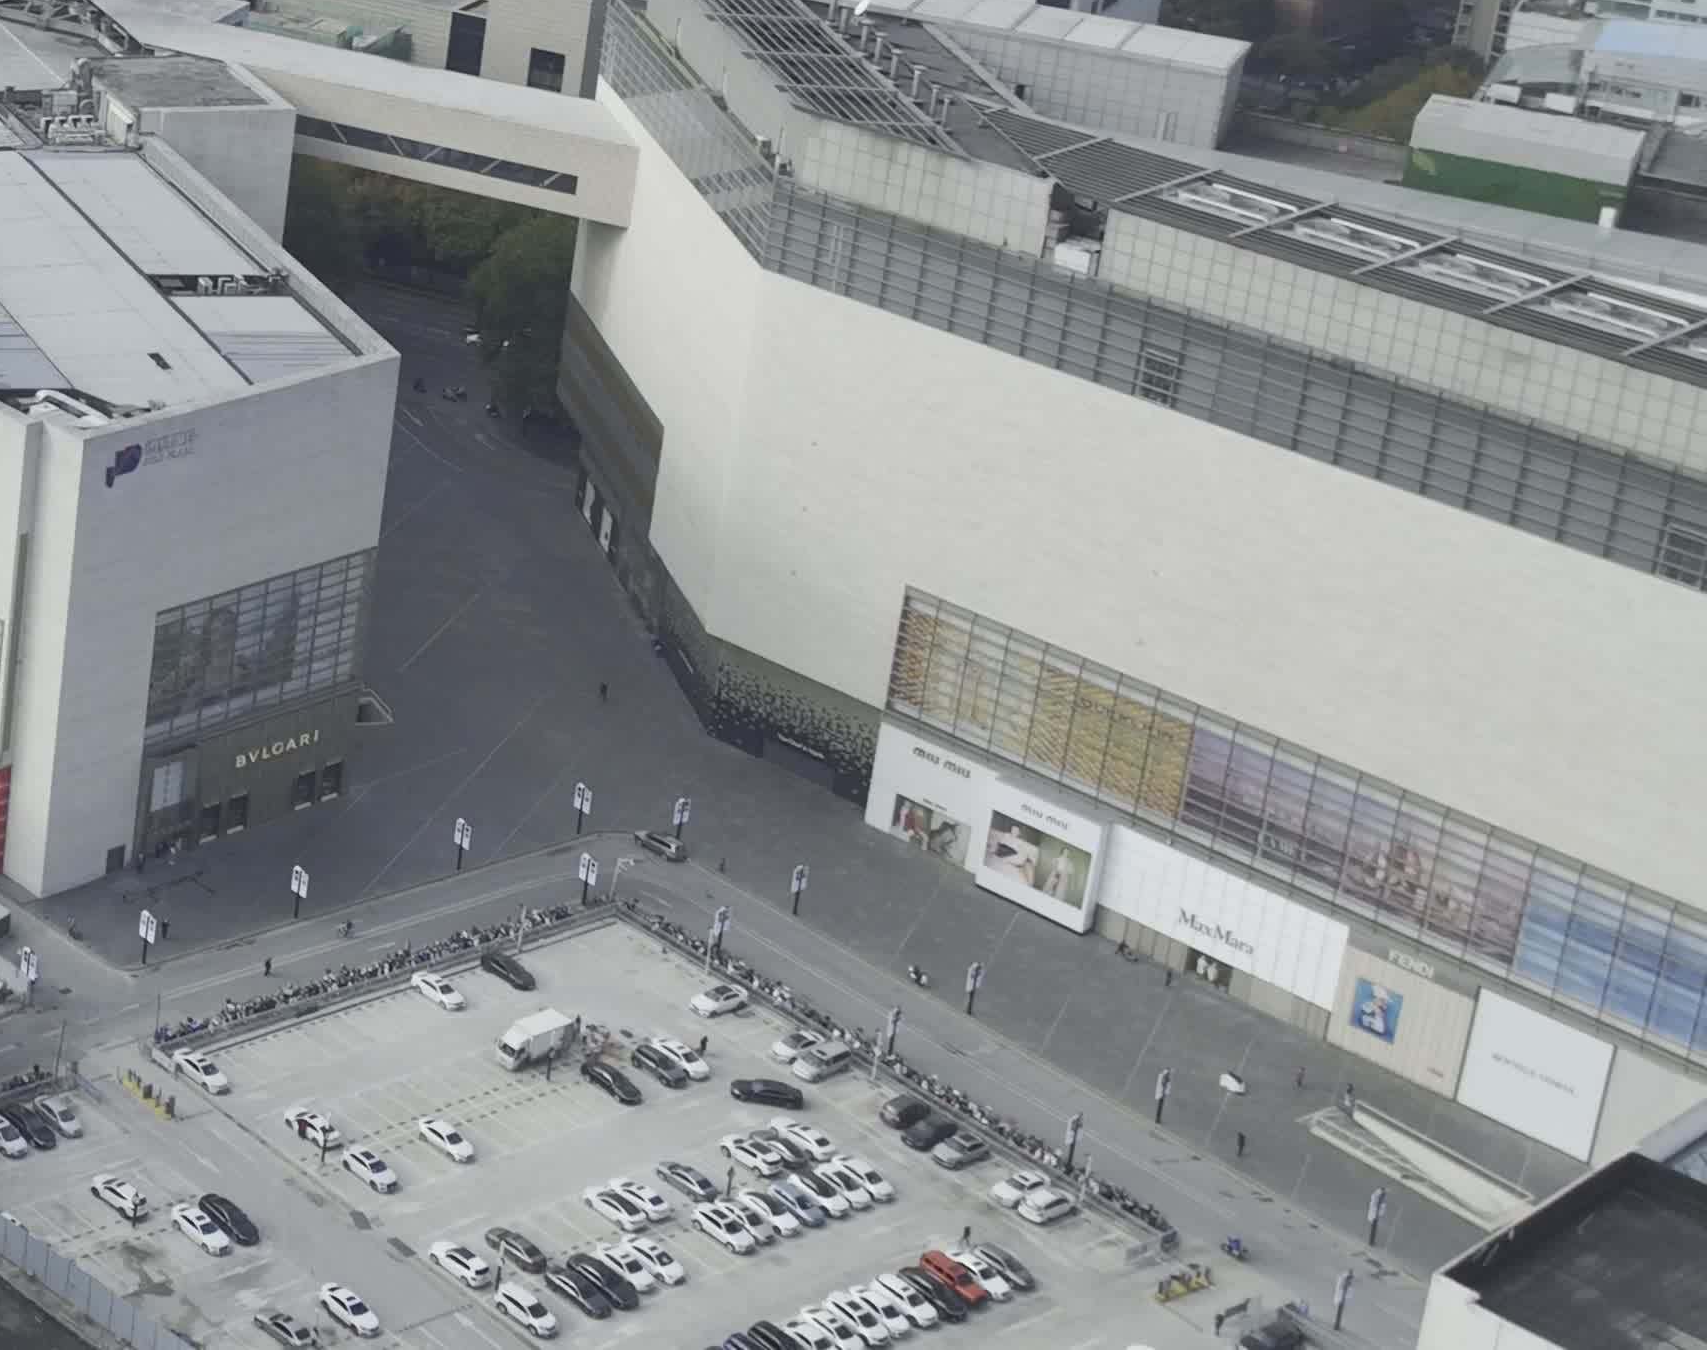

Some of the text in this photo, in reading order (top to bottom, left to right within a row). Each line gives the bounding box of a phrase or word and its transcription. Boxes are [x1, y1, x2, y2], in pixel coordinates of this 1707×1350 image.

[234, 729, 320, 768] BVLGARI
[912, 746, 971, 779] miu miu
[1178, 906, 1254, 955] MaxMara
[1388, 950, 1435, 978] FENDI
